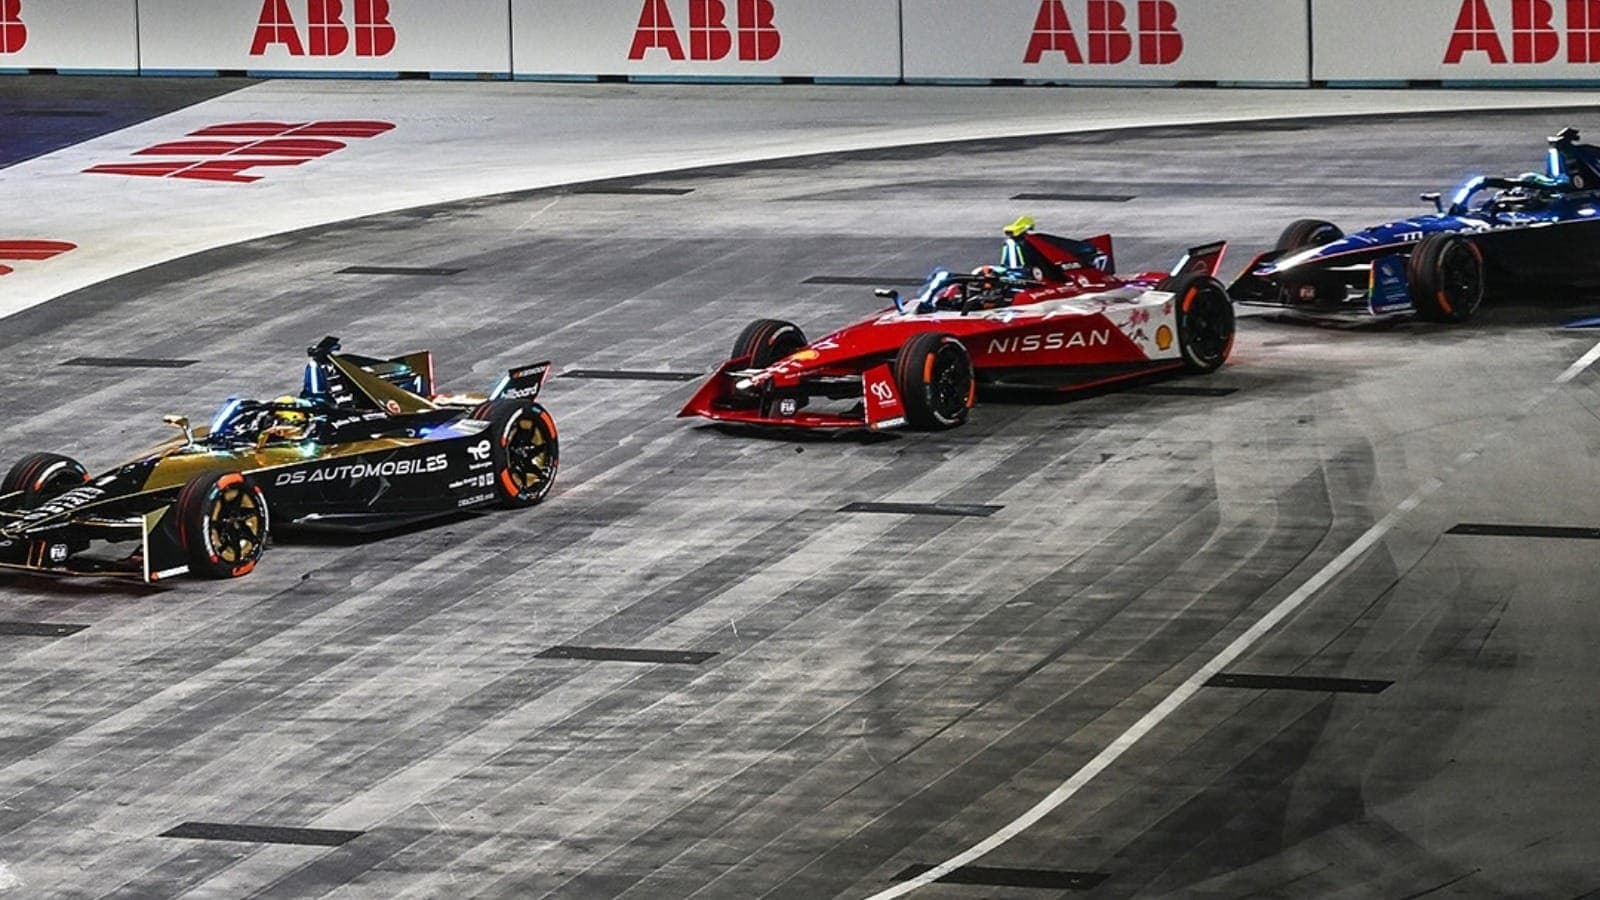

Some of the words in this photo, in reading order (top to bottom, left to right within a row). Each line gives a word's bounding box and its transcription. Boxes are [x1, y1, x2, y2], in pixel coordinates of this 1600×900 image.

[250, 0, 397, 57] ABB
[628, 0, 781, 62] ABB
[1023, 0, 1184, 65] ABB
[1442, 0, 1600, 64] ABB
[987, 329, 1110, 354] NISSAN
[780, 402, 795, 413] FIA
[274, 470, 307, 487] DS
[307, 453, 449, 483] AUTOMOBILES
